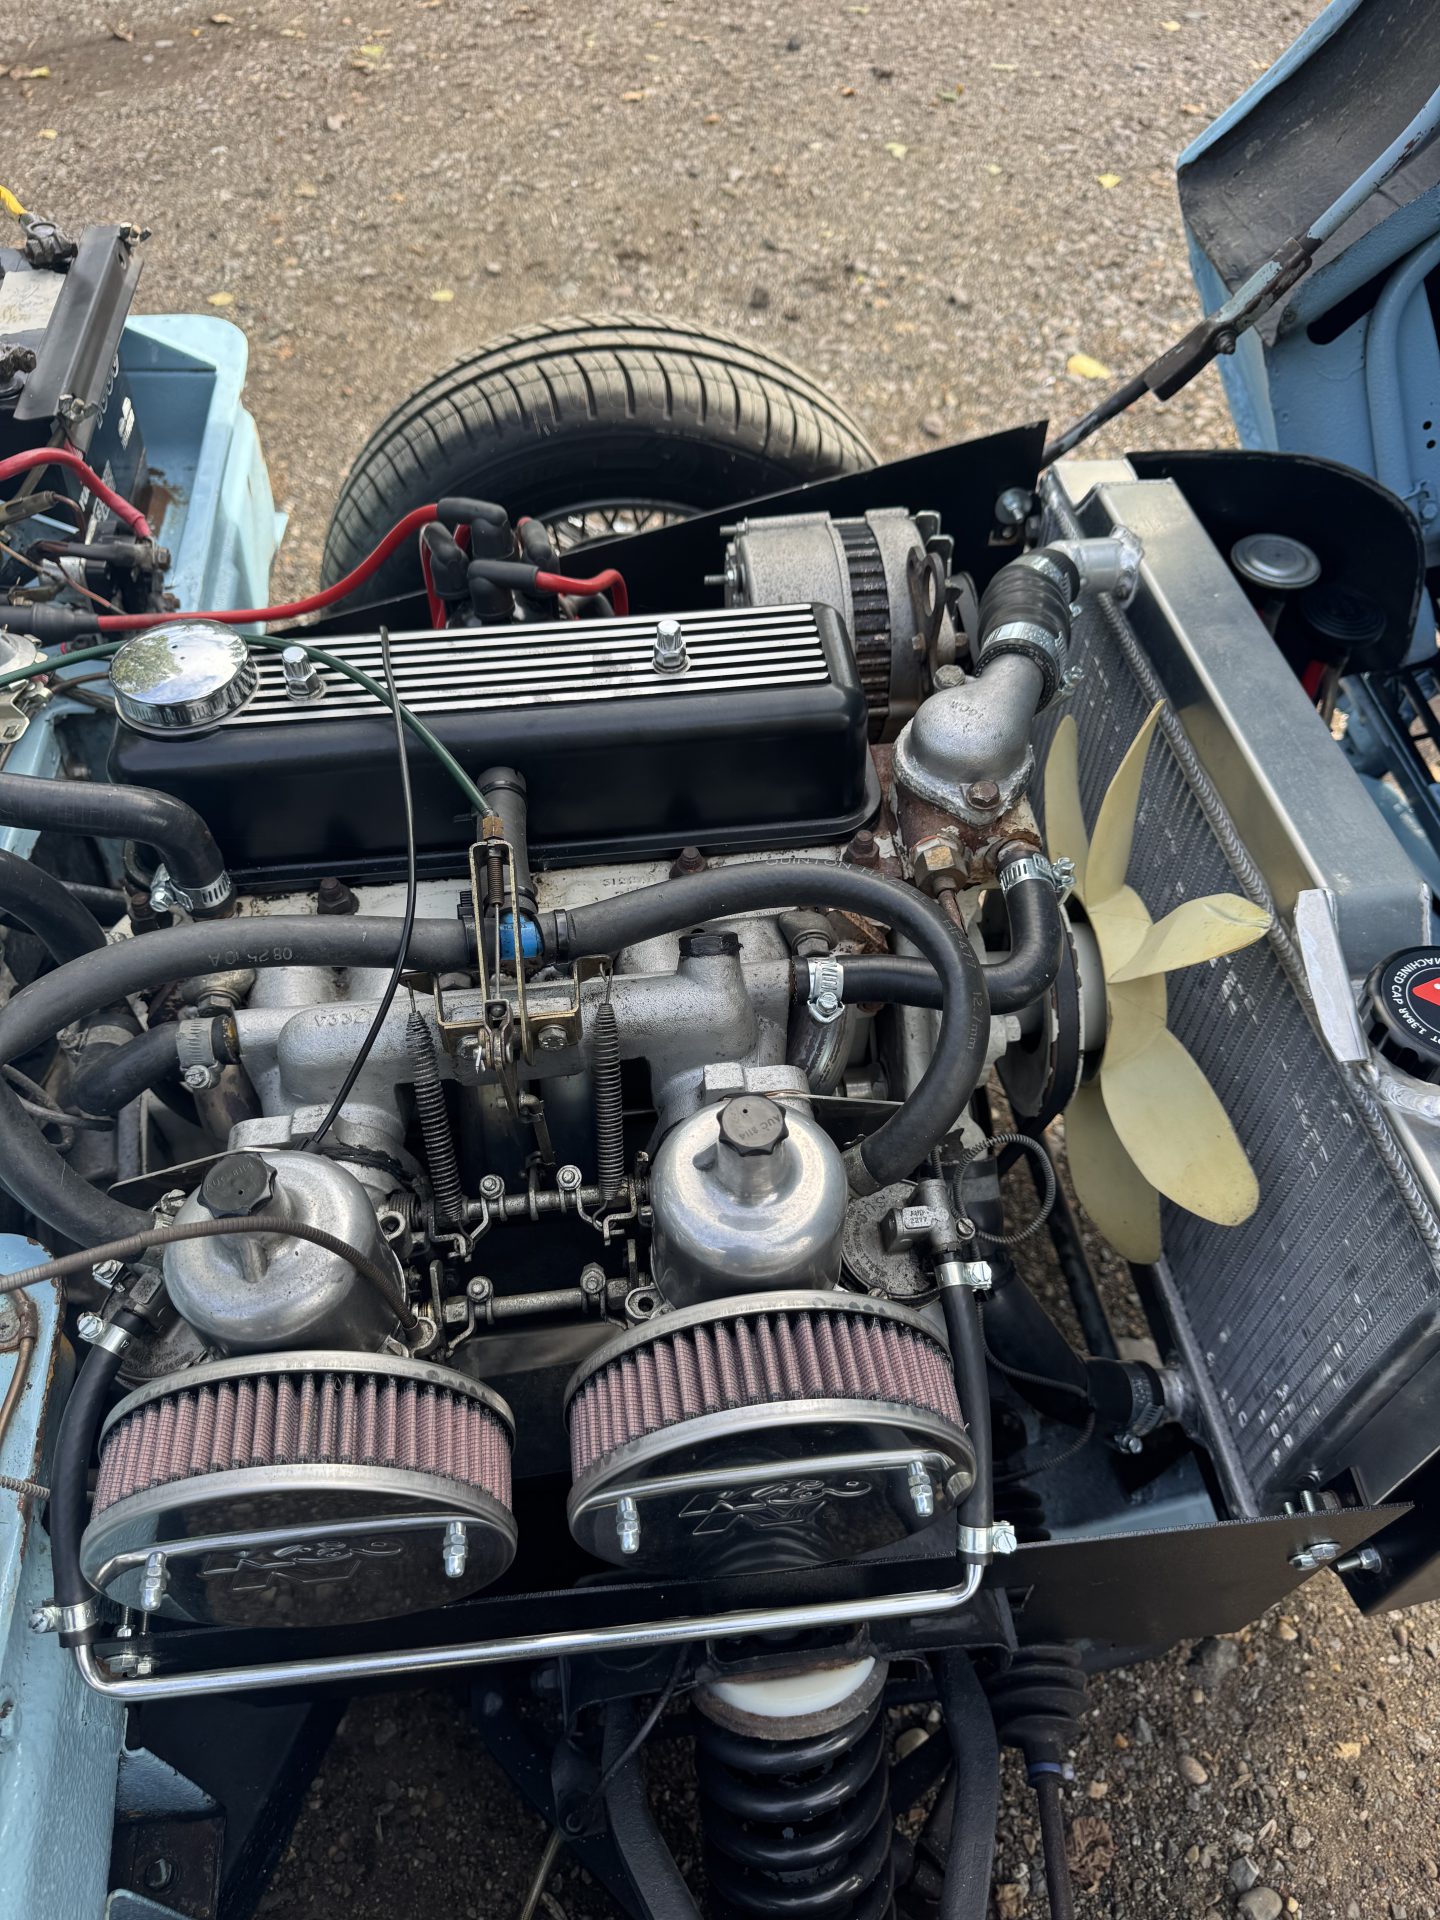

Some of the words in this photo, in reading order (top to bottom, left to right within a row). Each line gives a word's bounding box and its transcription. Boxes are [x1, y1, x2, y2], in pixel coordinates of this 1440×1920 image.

[766, 857, 851, 870] QUINTON
[1394, 957, 1440, 984] MACHINED
[1391, 985, 1404, 1005] CAP
[1398, 1007, 1428, 1035] 1.3BAR
[760, 1113, 782, 1131] AUC
